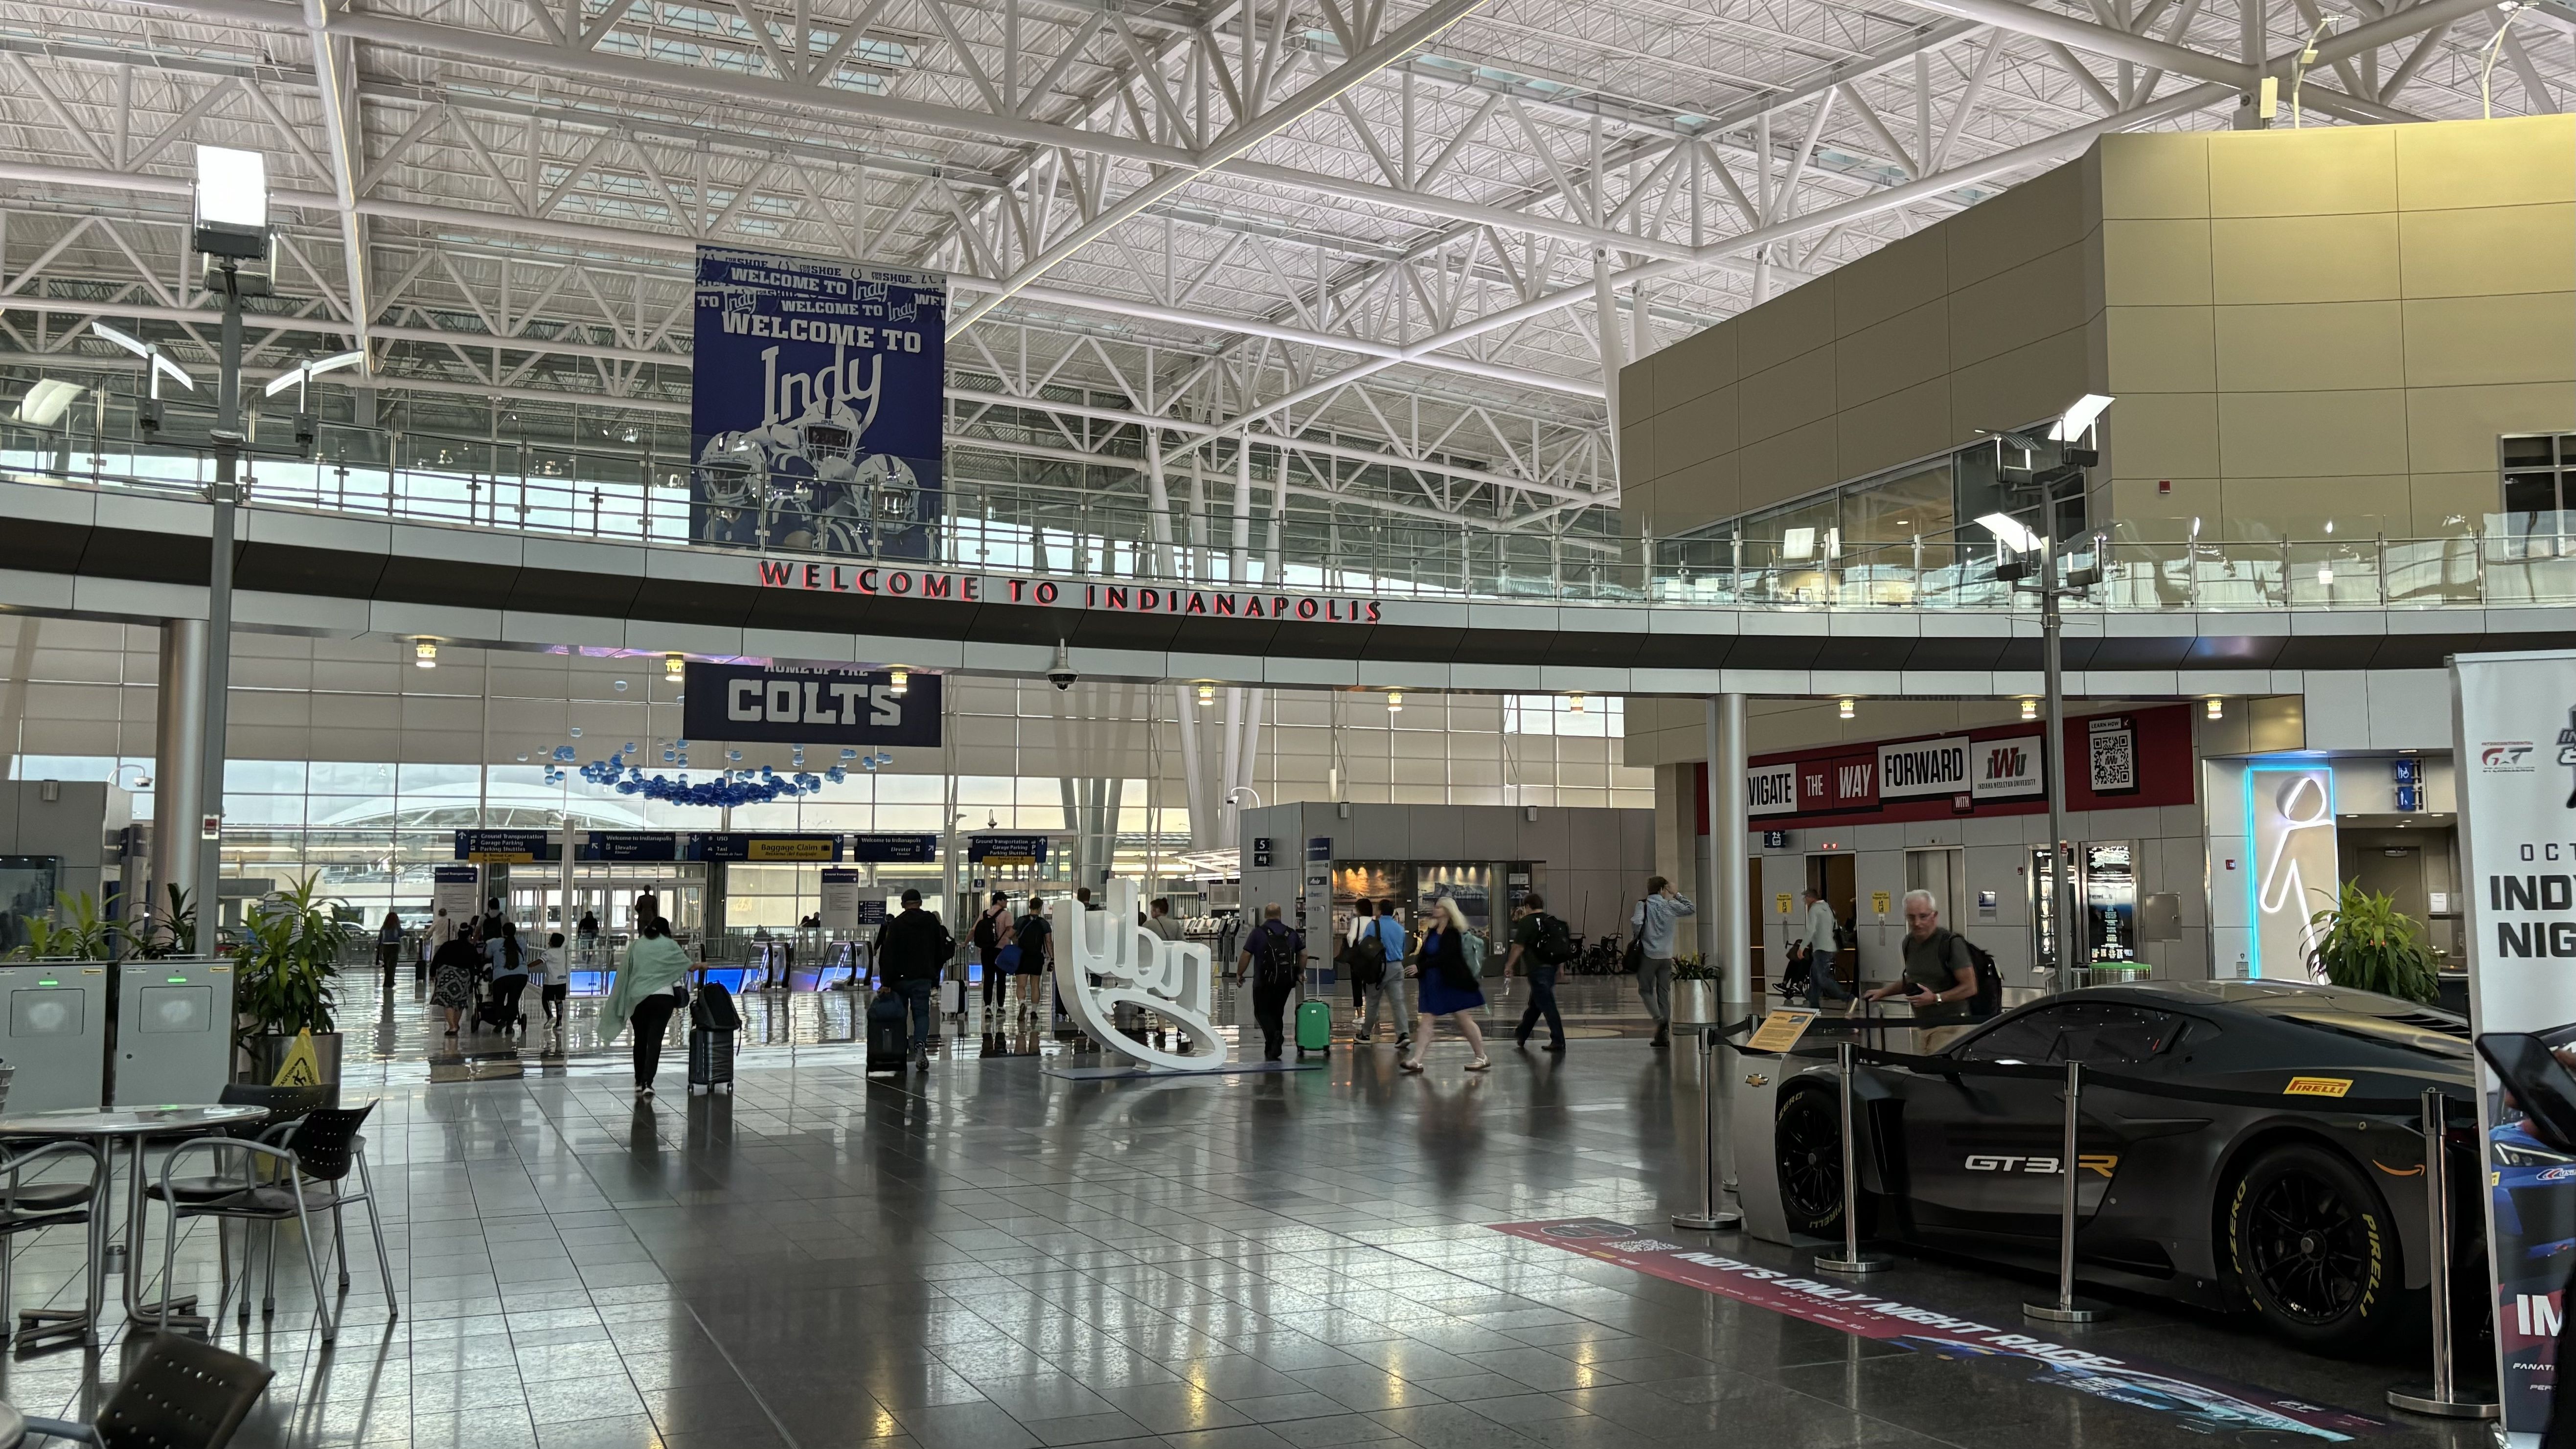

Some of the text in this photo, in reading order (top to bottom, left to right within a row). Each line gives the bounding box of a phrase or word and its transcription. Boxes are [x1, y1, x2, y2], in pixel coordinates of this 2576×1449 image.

[731, 267, 889, 302] WELCOME TO Indy
[811, 265, 841, 276] SHOE
[882, 273, 912, 284] SHOE
[697, 295, 719, 307] TO
[723, 290, 757, 315] Indy
[781, 299, 917, 323] WELCOME TO Indy
[722, 311, 921, 353] WELCOME TO
[761, 342, 882, 433] Indy
[759, 561, 1381, 622] WELCOME TO INDIANAPOLIS
[728, 679, 901, 726] COLTS
[1748, 747, 1963, 806] VIGATE THE WAY FORWARD
[1955, 795, 1969, 808] WITH
[761, 844, 794, 853] Baggage
[1259, 840, 1265, 849] 5
[2490, 875, 2576, 910] IND
[2498, 922, 2576, 957] NIG
[2288, 1080, 2348, 1094] PIRELLI
[1775, 1091, 1803, 1127] ZERO
[1809, 1200, 1843, 1228] PIRELLI
[2362, 1213, 2382, 1317] PIRELLI
[1670, 1251, 2125, 1367] INDY'S ONLY NIGHT RACE
